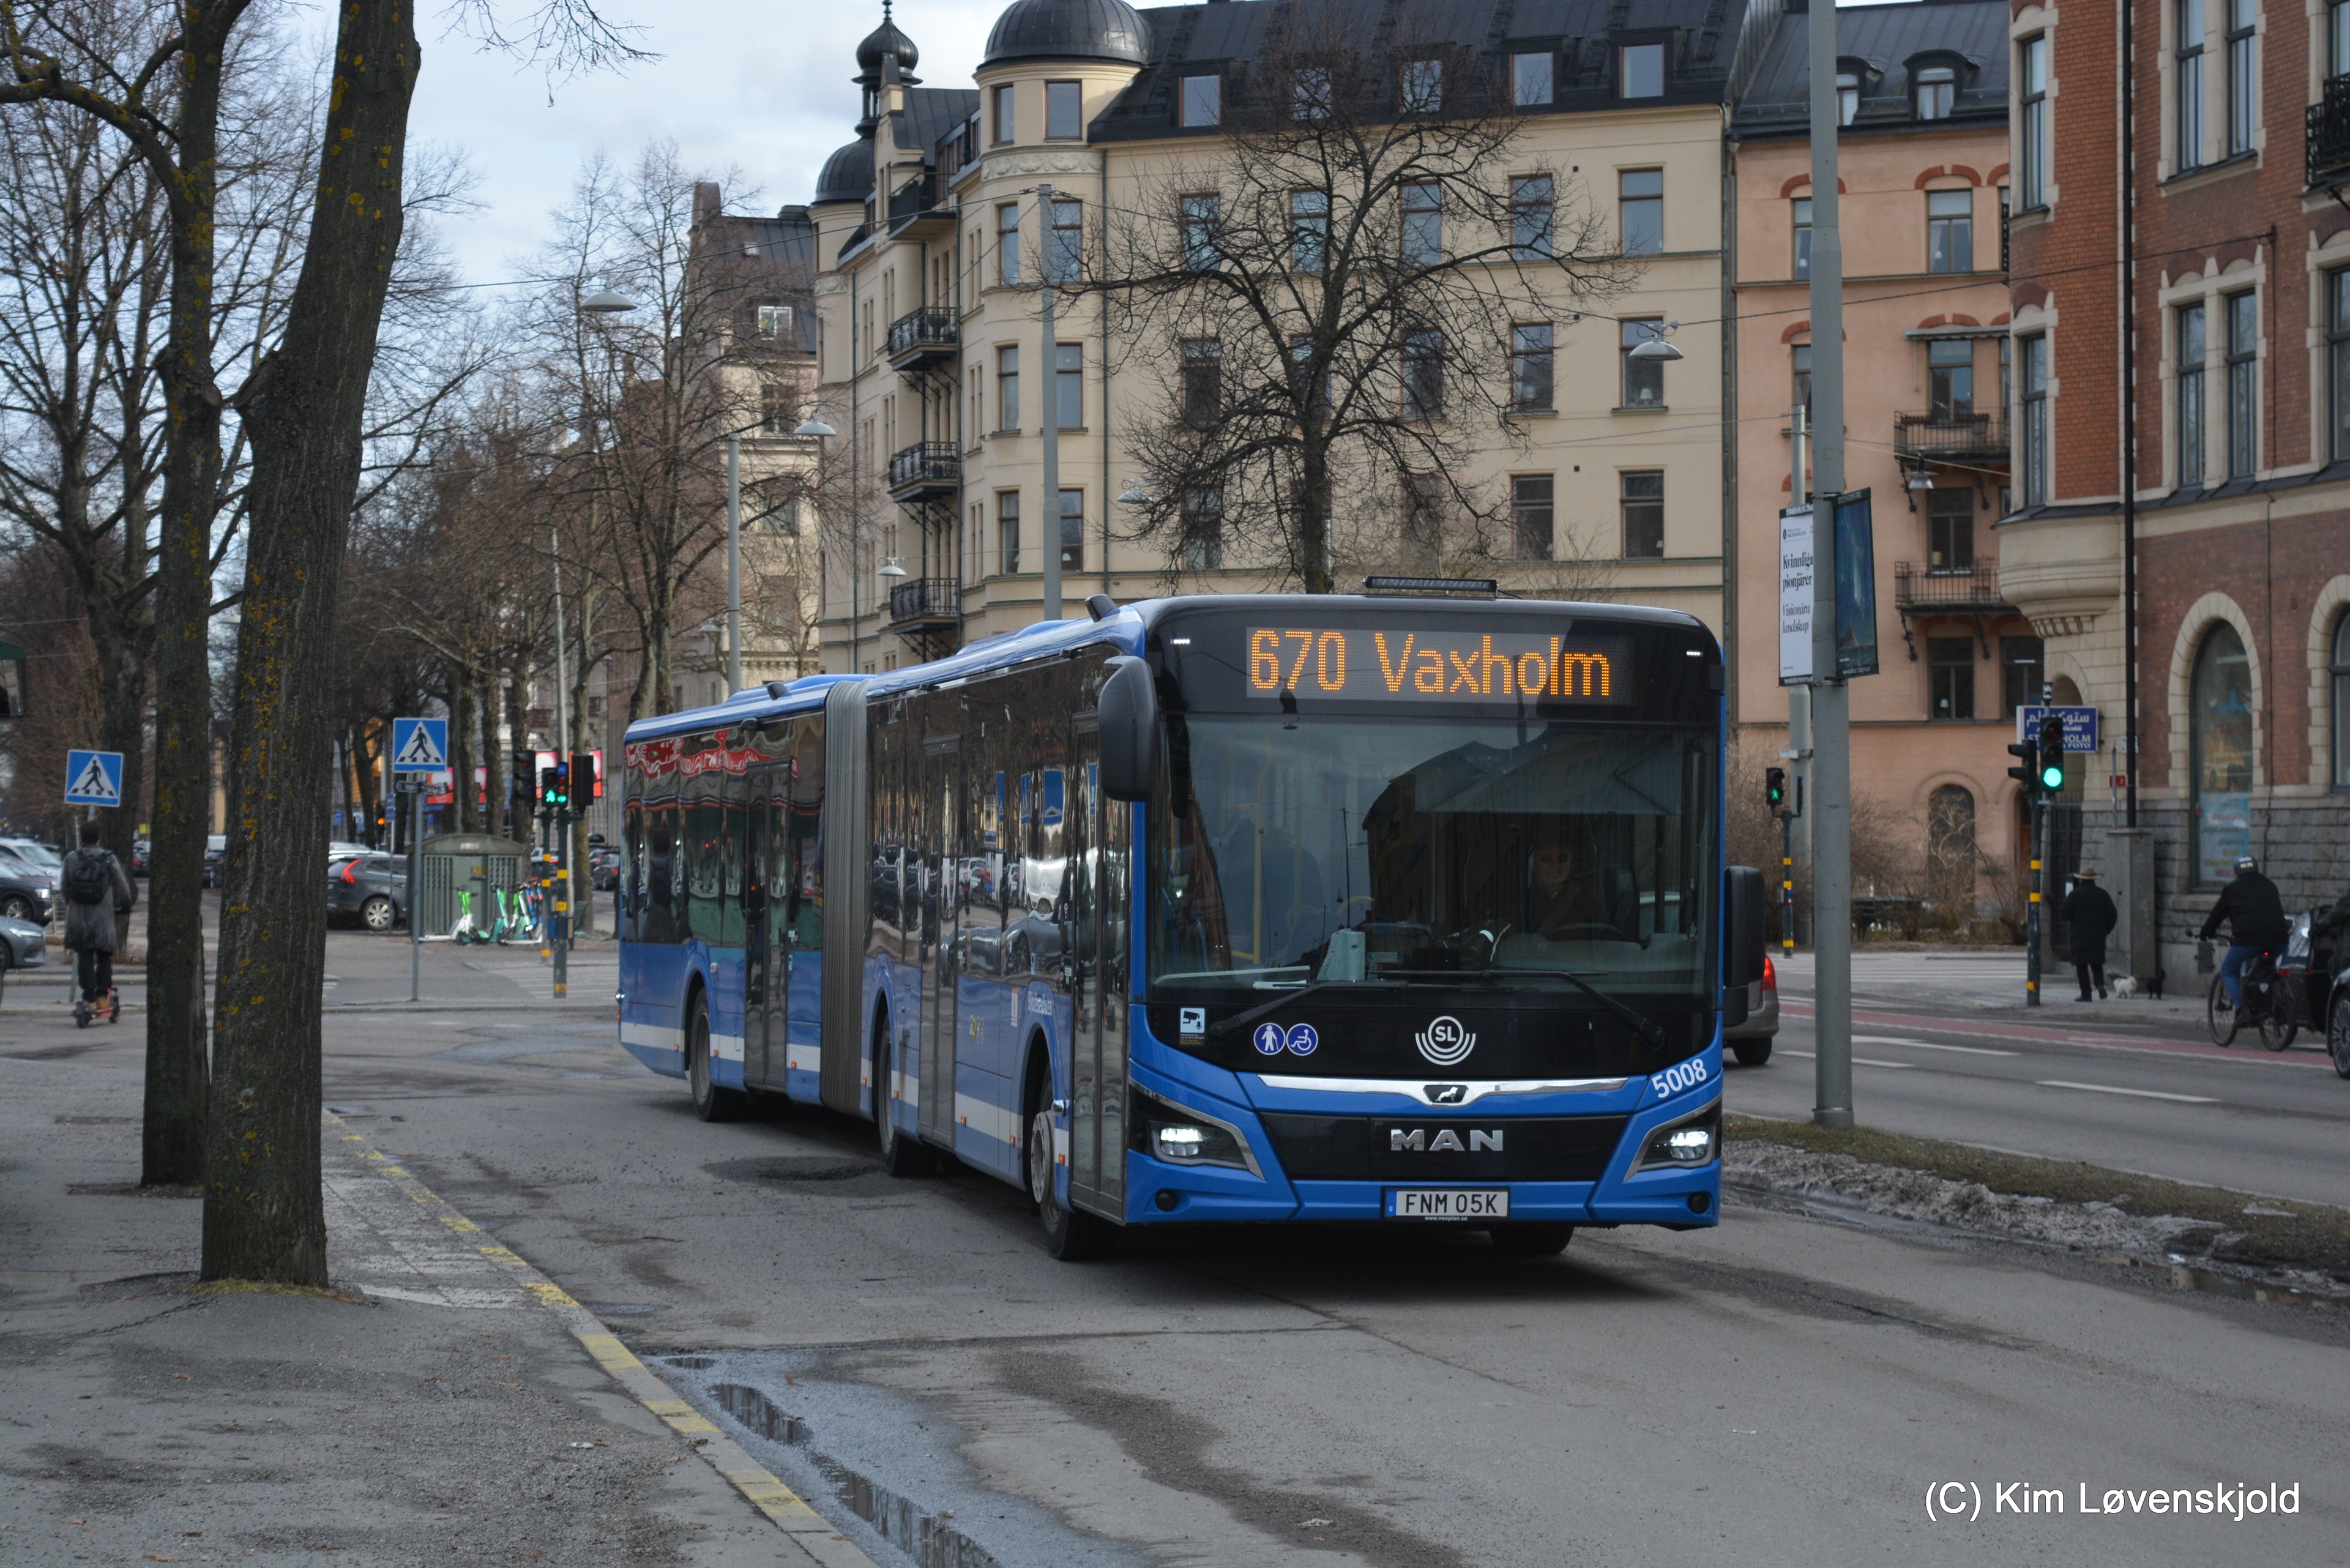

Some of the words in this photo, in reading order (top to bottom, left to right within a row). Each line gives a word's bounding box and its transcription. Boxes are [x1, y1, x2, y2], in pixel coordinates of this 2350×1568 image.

[1783, 551, 1813, 570] Kvinnliga
[1783, 572, 1812, 592] pionjärer
[1783, 603, 1810, 616] Visionära
[1782, 619, 1809, 633] landskap
[1251, 630, 1345, 690] 670
[1375, 632, 1610, 696] Vaxholm
[1434, 1026, 1457, 1042] SL
[1652, 1058, 1707, 1098] 5008
[1390, 1129, 1504, 1151] MAN
[1405, 1193, 1448, 1214] FNM
[1455, 1193, 1498, 1214] 05K
